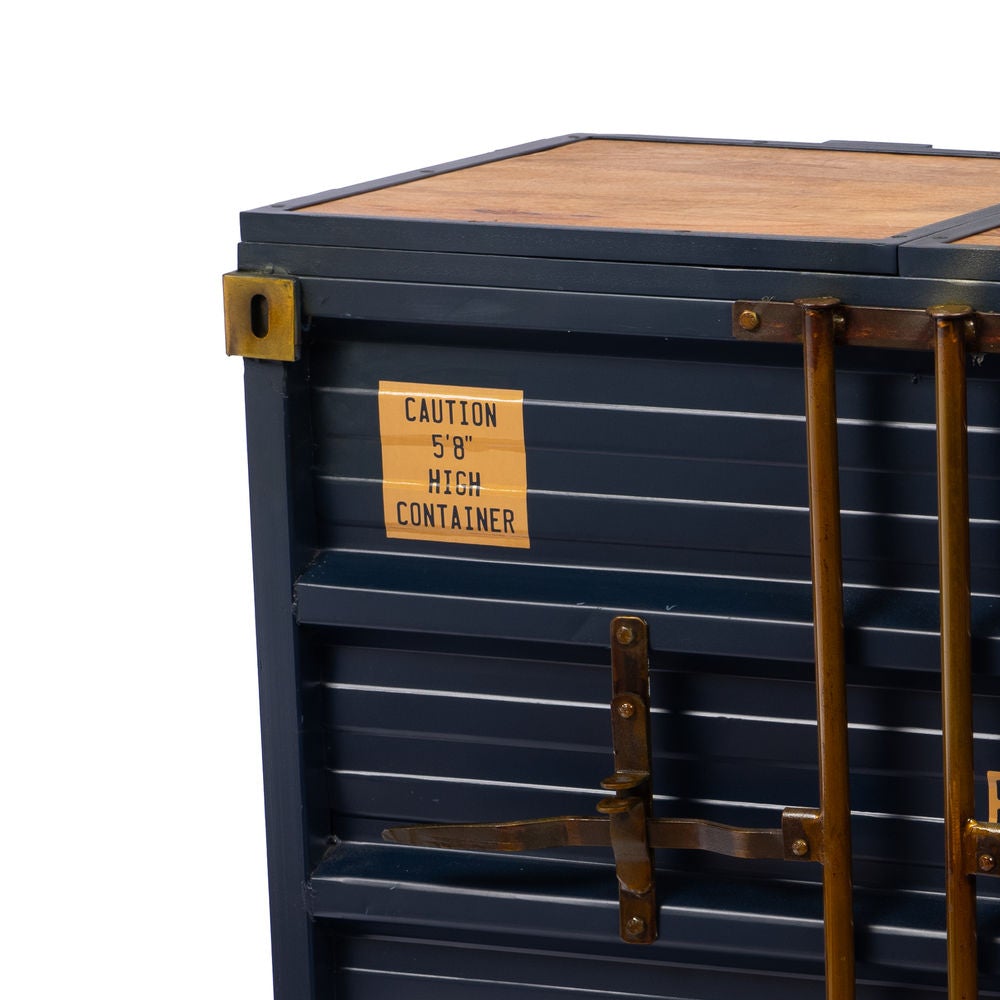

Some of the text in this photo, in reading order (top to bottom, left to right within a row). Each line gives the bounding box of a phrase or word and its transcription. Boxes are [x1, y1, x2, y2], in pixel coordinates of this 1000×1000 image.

[405, 397, 497, 427] CAUTION
[432, 434, 472, 460] 5'8"
[428, 469, 481, 497] HIGH
[396, 501, 515, 534] CONTAINER
